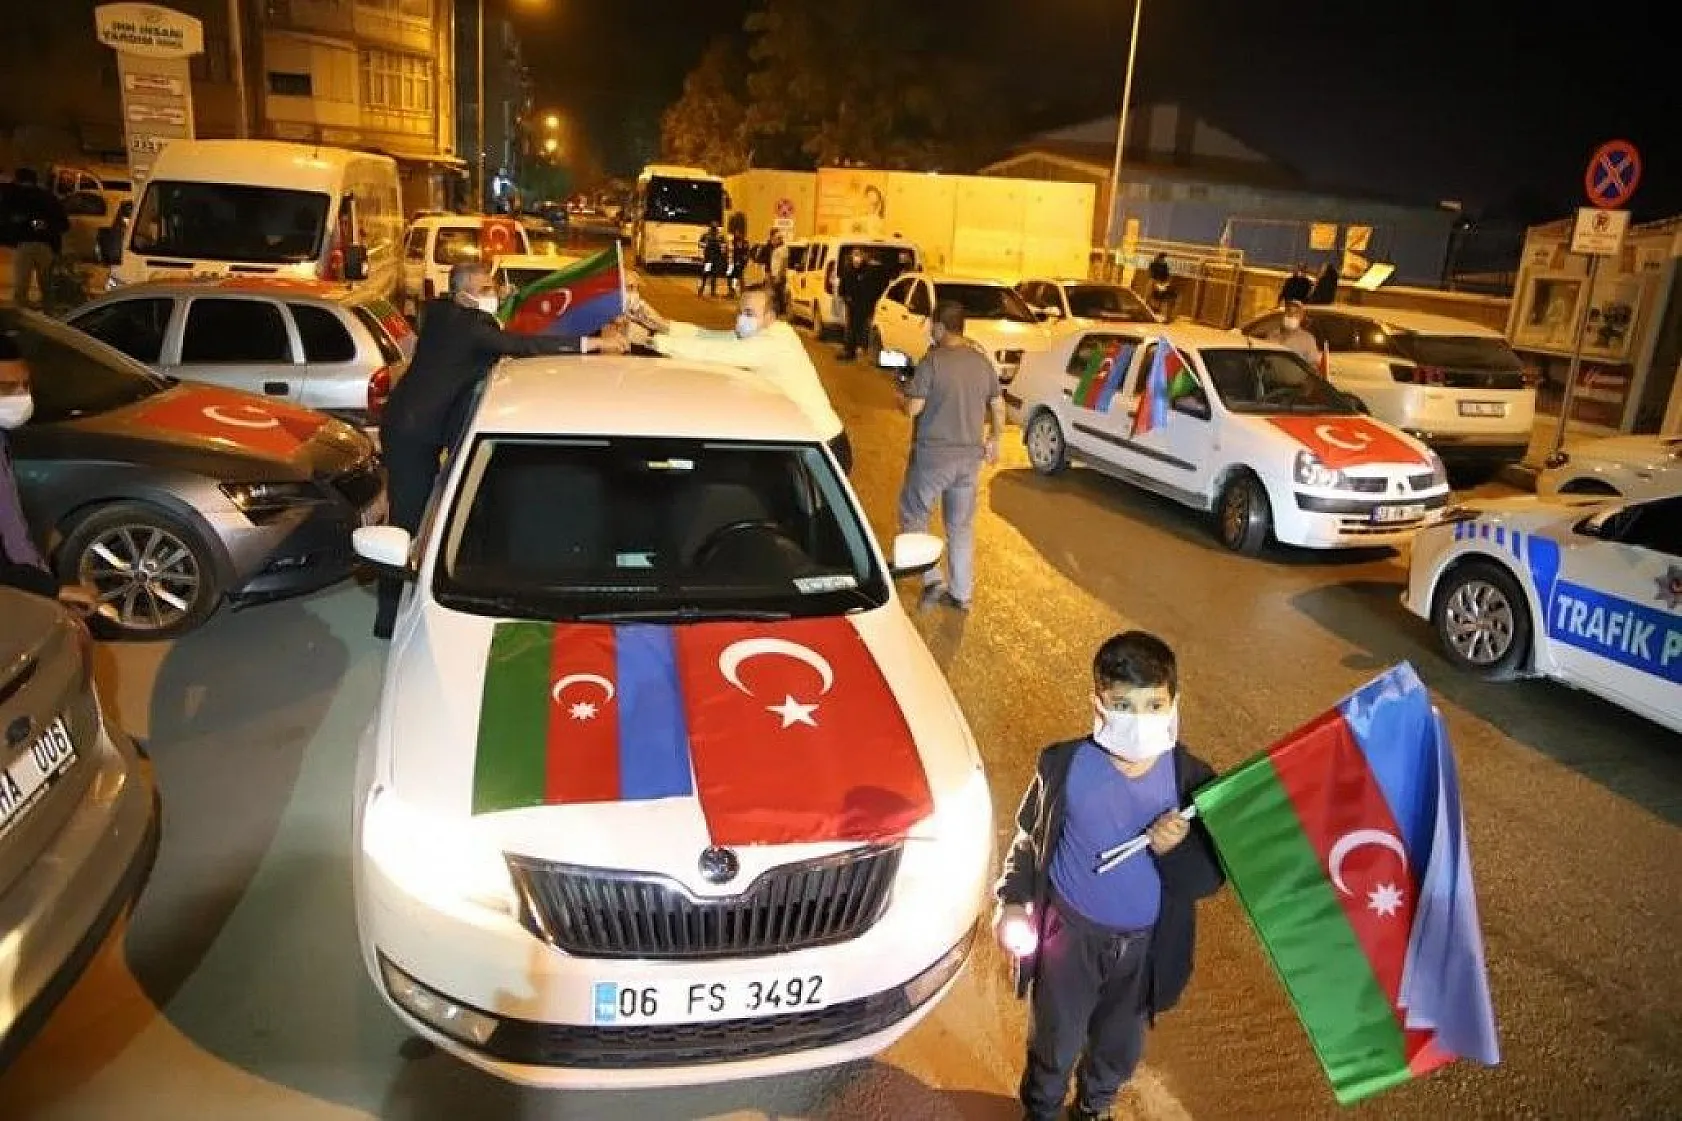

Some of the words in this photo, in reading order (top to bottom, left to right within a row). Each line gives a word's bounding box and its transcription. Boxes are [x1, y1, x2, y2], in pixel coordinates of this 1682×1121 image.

[1557, 594, 1657, 662] TRAFİK
[619, 987, 658, 1017] 06
[687, 983, 727, 1014] FS
[747, 975, 823, 1010] 3492
